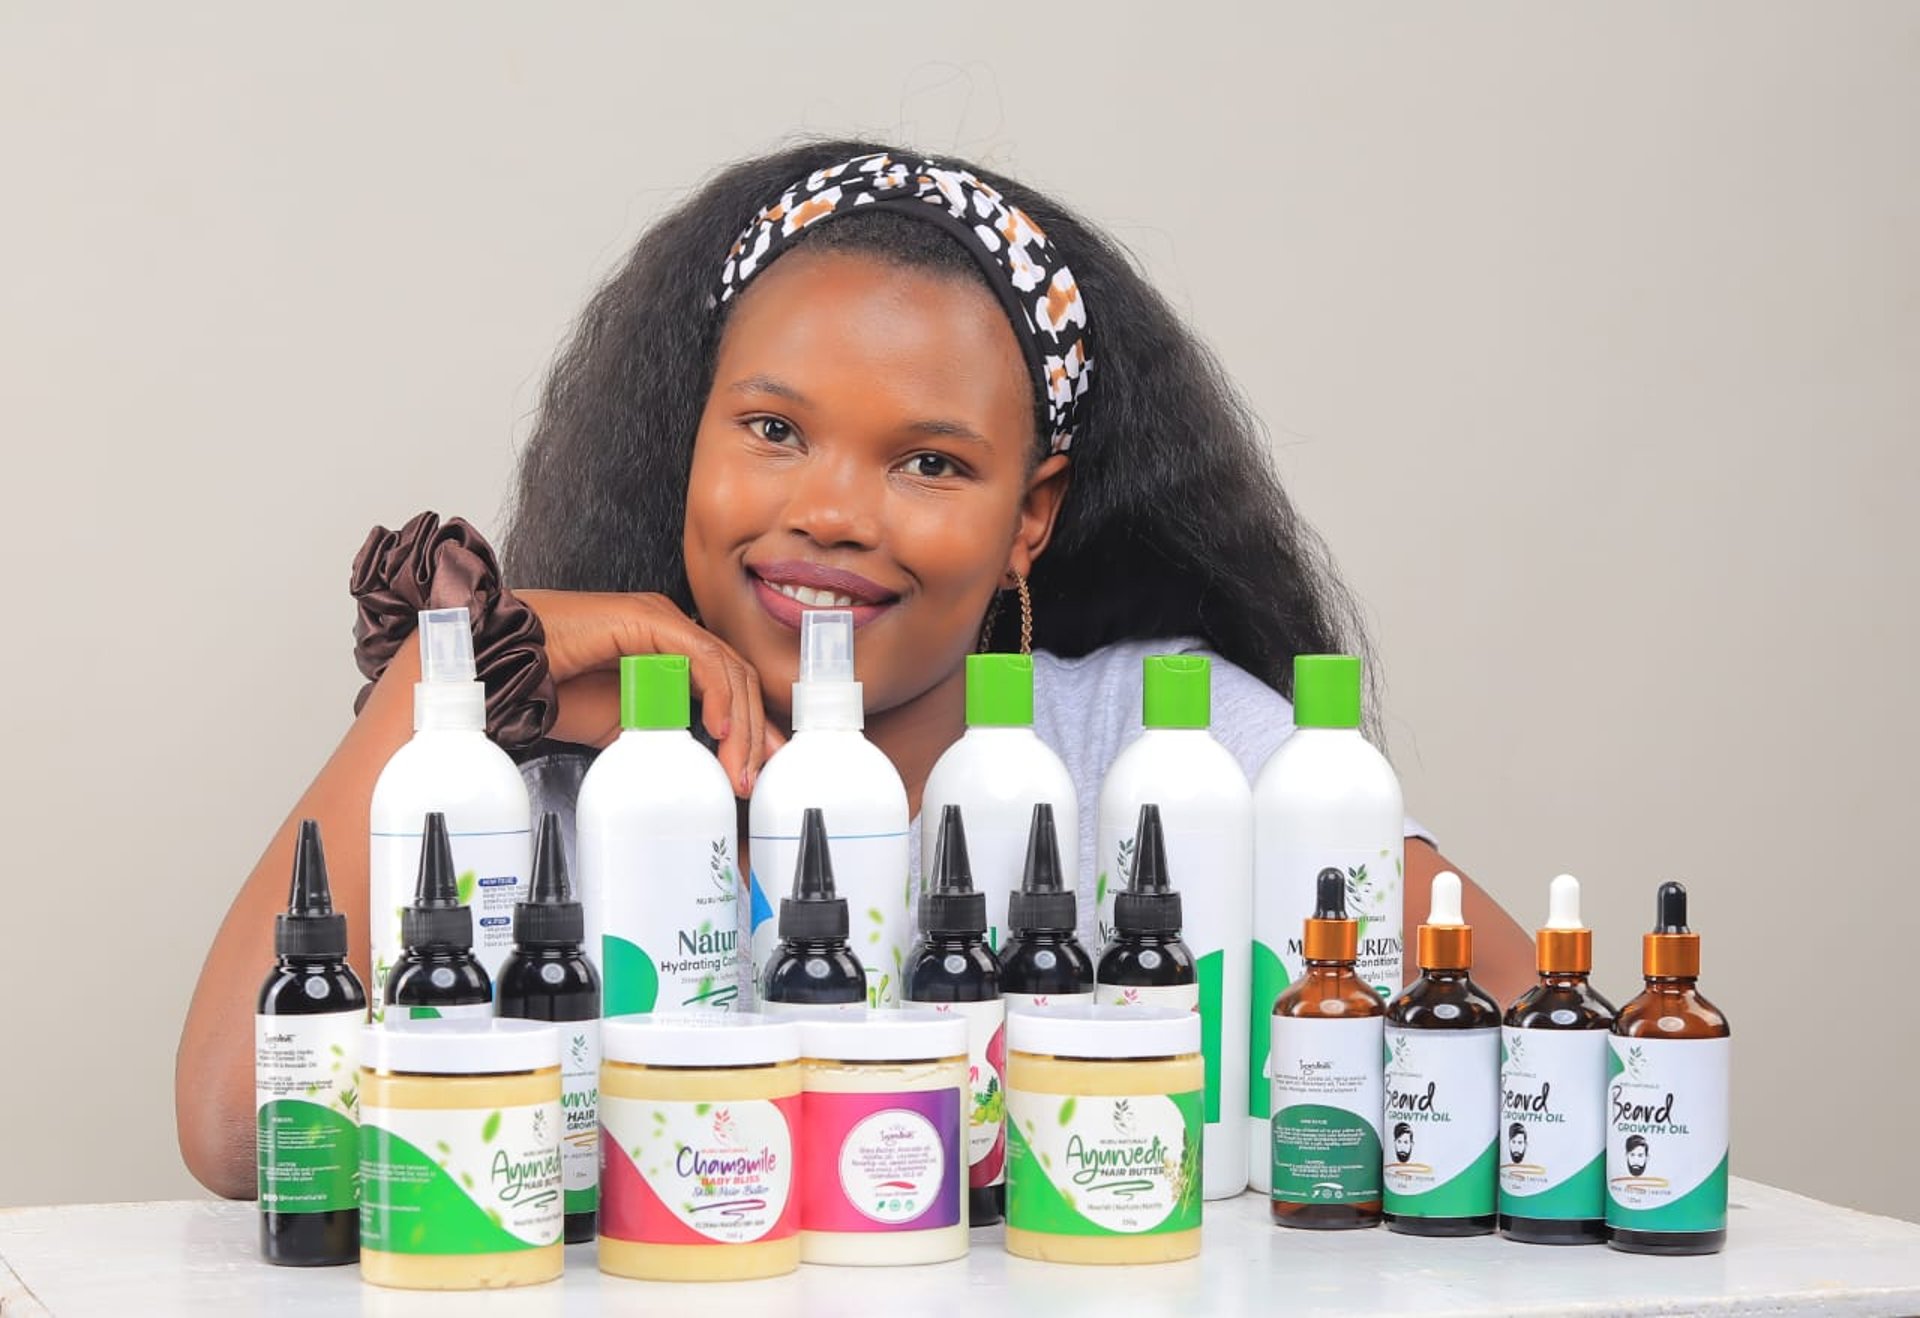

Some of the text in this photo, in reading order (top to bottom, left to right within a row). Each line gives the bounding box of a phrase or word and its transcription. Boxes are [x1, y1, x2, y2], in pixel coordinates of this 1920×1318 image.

[661, 957, 721, 975] Hydrating
[1611, 1085, 1674, 1125] Beard
[567, 1109, 595, 1122] HAIR
[1431, 1111, 1452, 1122] OIL
[1546, 1113, 1566, 1123] OIL
[1618, 1122, 1690, 1134] GROWTH OIL
[676, 1146, 776, 1178] Chamomile
[1066, 1134, 1168, 1184] Ayurvedic
[1100, 1166, 1164, 1176] HAIR BUTTER
[733, 1175, 760, 1185] BLISS
